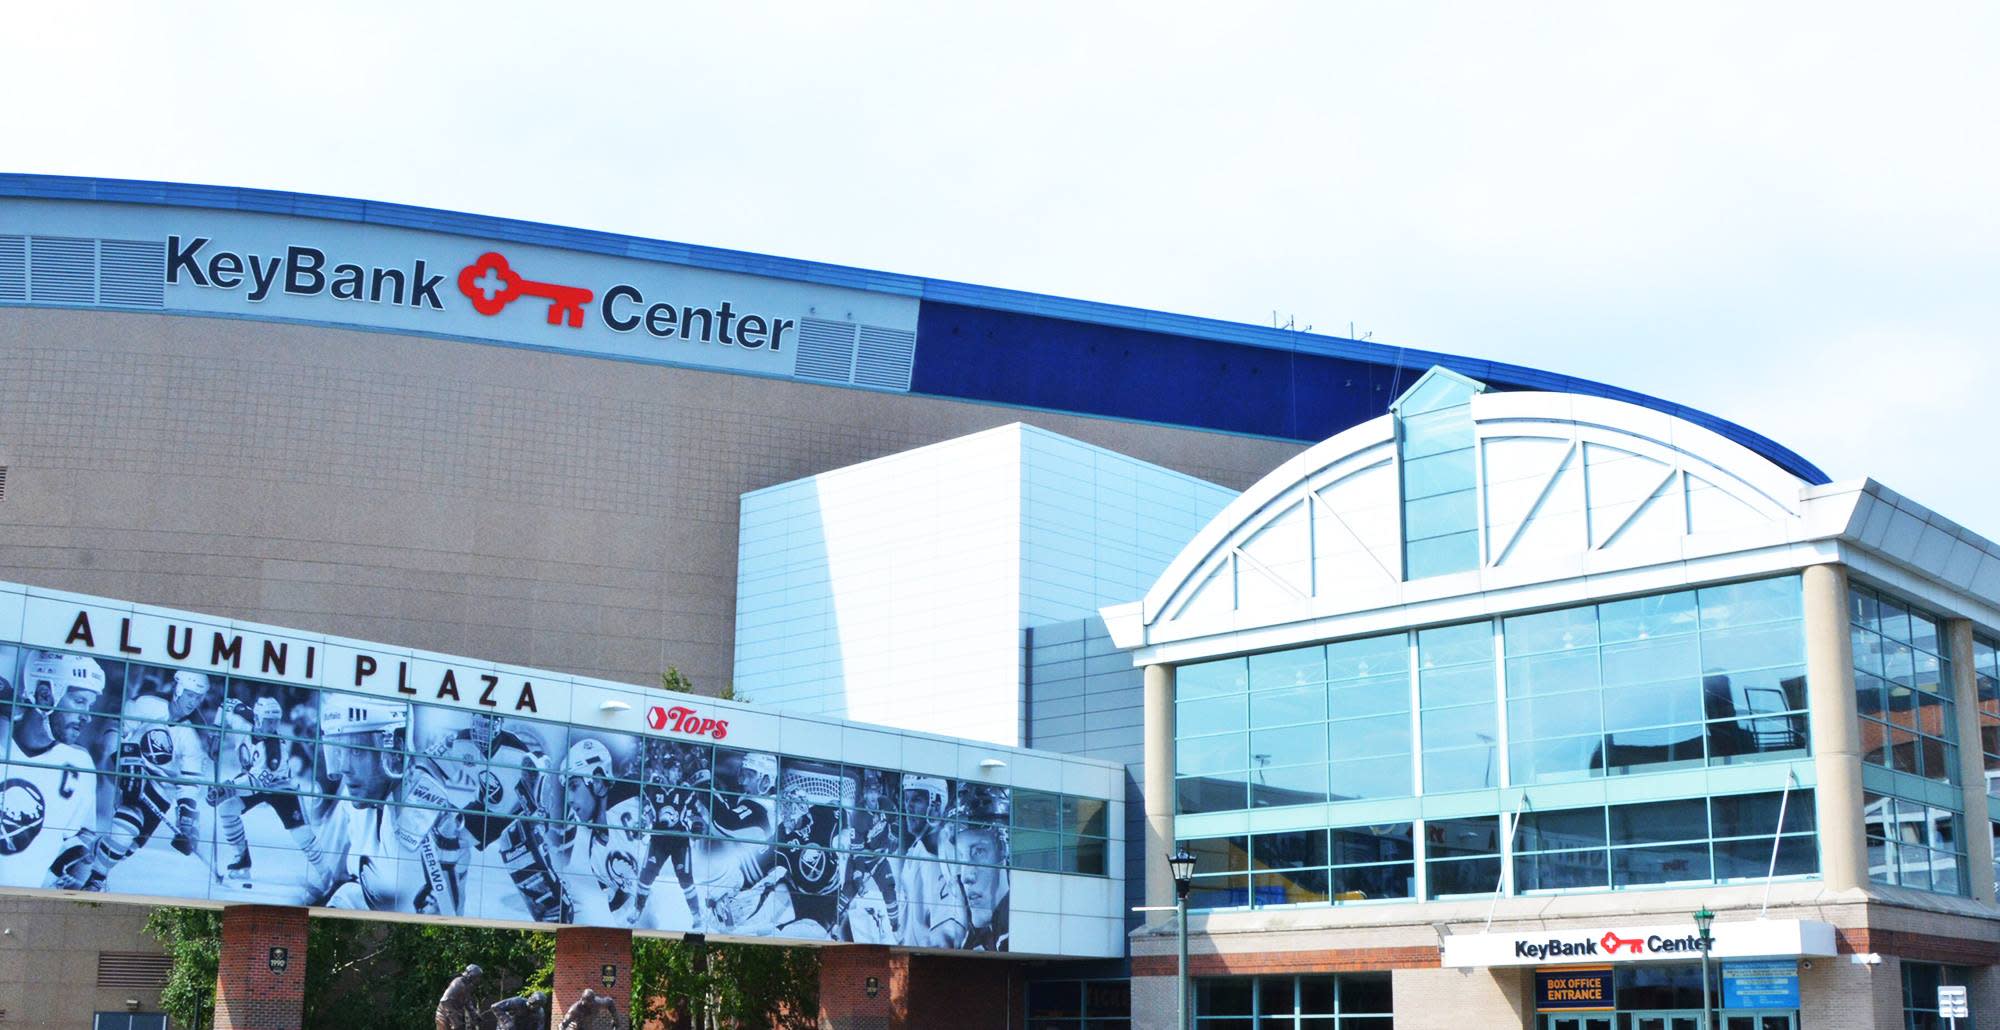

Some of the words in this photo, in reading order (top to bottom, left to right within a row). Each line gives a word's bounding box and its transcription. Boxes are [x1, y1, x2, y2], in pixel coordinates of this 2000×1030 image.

[165, 234, 446, 311] KeyBank
[601, 283, 795, 352] Center
[65, 610, 315, 679] ALUMNI
[355, 655, 538, 713] PLAZA
[1515, 937, 1597, 961] KeyBank
[1647, 934, 1715, 952] Center
[1547, 979, 1567, 989] BOX
[1568, 977, 1602, 989] OFFICE
[1547, 988, 1603, 1001] ENTRANCE
